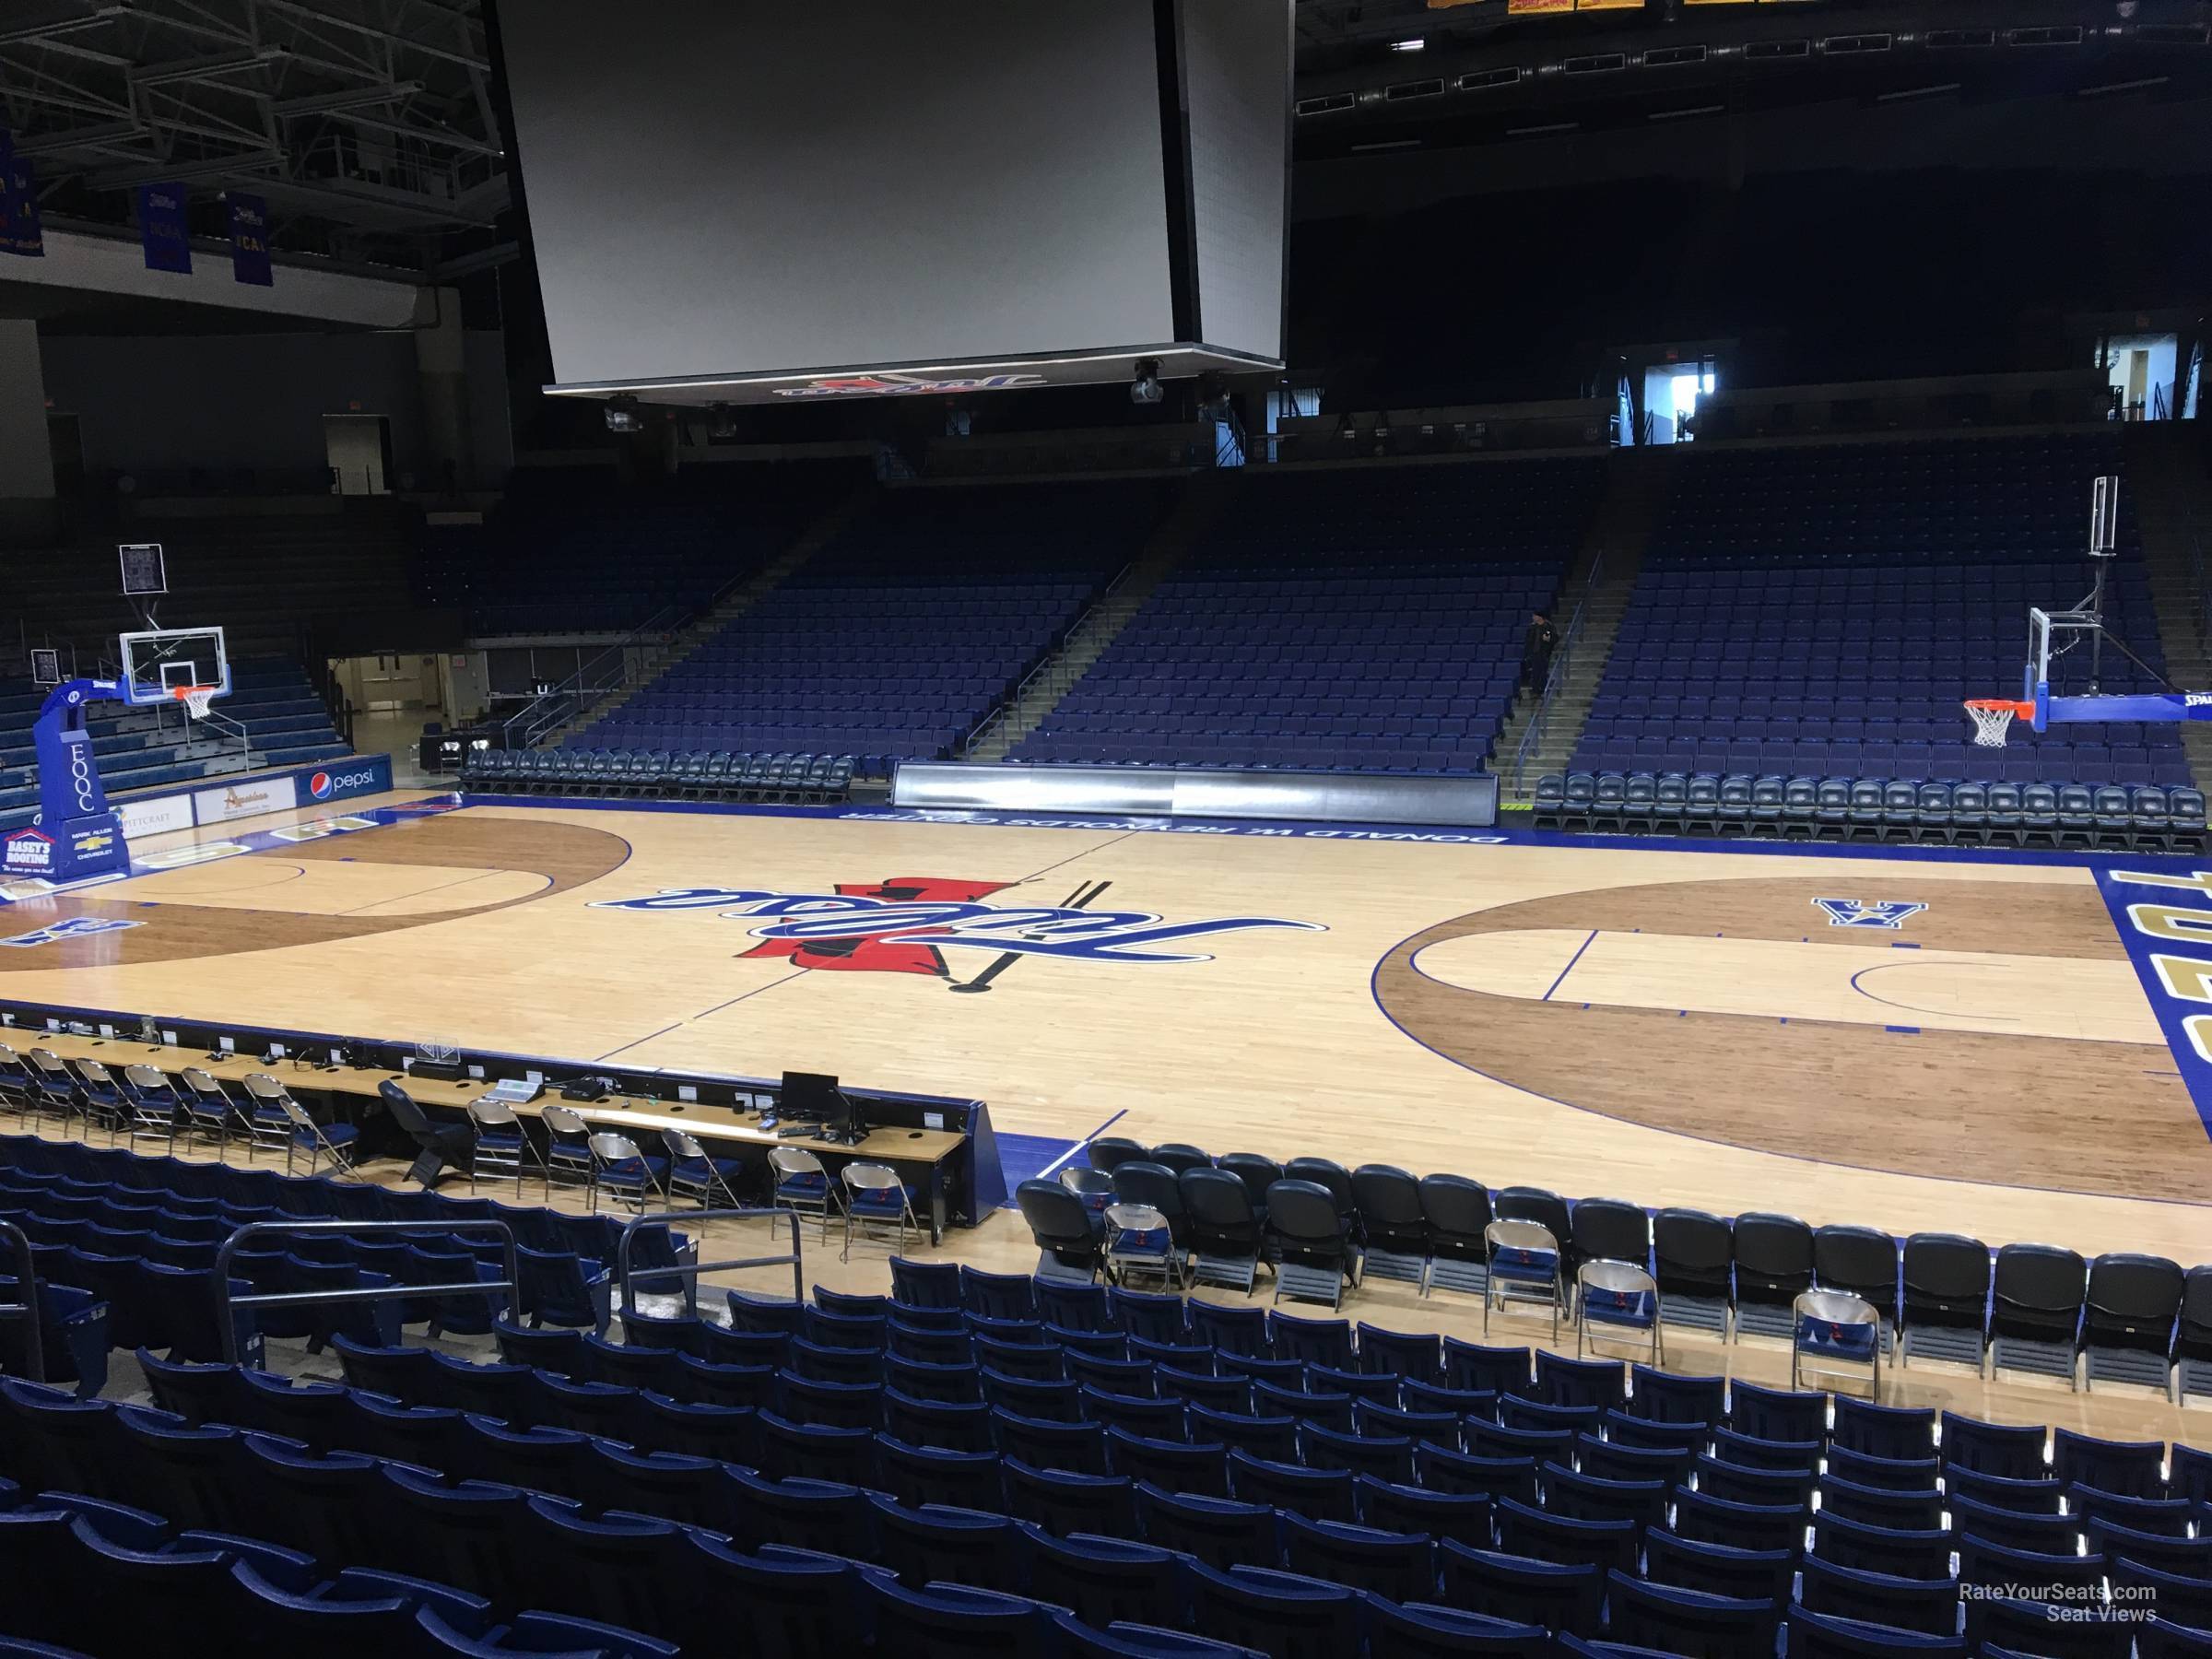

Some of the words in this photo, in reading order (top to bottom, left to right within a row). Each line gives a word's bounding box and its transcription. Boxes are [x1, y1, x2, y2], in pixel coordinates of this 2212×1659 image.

[2185, 694, 2212, 706] SPAL
[334, 768, 373, 793] pepsi
[124, 813, 171, 828] PITTCRAFT
[839, 813, 1000, 825] CENTER
[1005, 818, 1238, 833] REYNOLDS
[1305, 830, 1511, 843] DONALD
[7, 841, 50, 854] BASEY'S
[6, 852, 50, 865] ROOFING
[585, 887, 1332, 965] Tulsa
